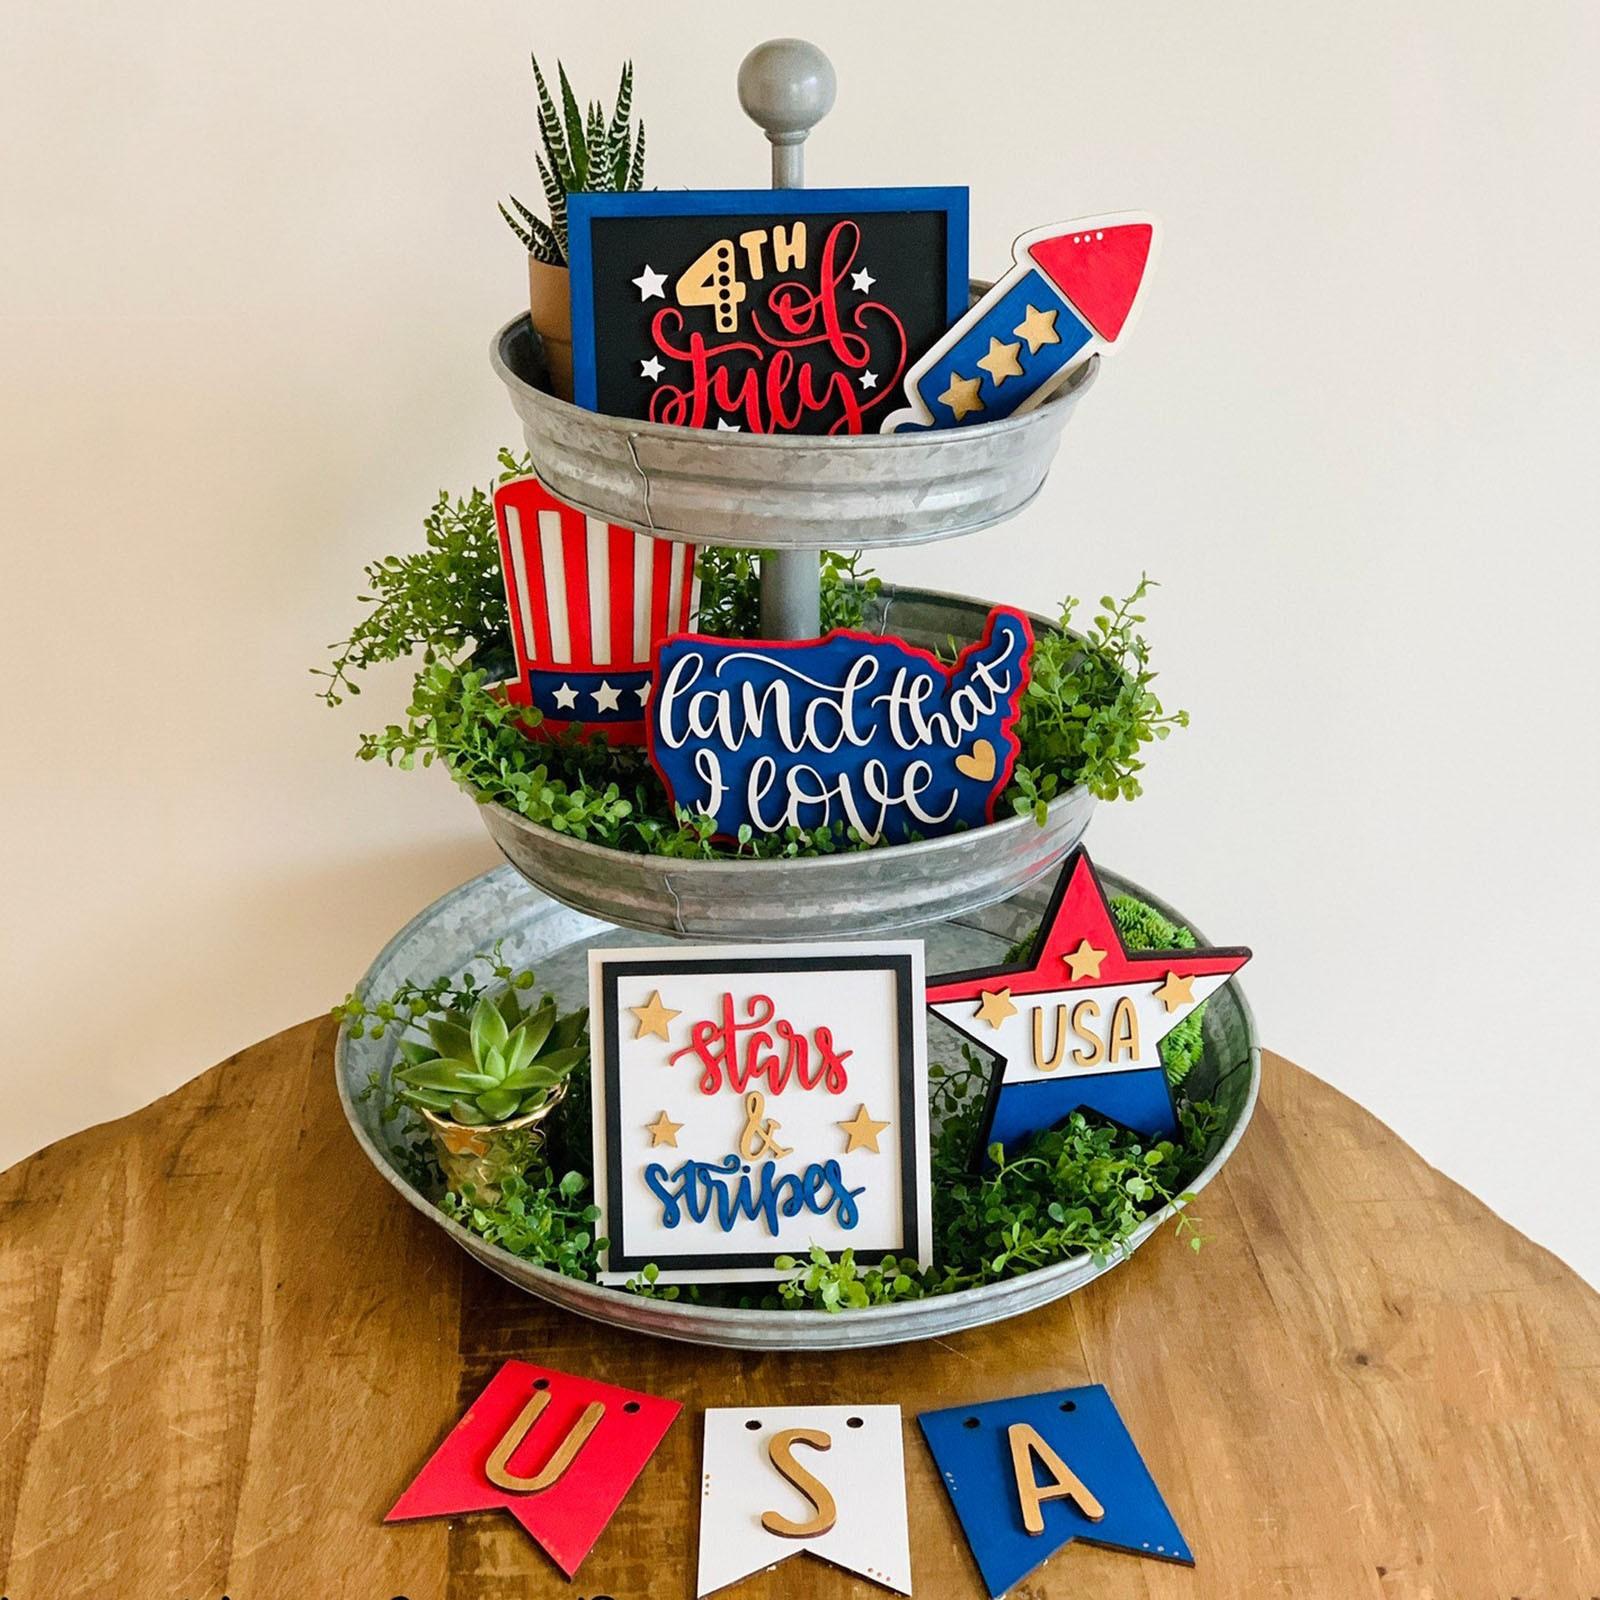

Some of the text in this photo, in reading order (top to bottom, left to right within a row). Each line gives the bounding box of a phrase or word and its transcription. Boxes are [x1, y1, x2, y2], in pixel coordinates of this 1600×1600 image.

[676, 219, 870, 368] 4TH of
[650, 302, 907, 436] July
[659, 628, 1014, 754] land that
[748, 755, 958, 845] love
[669, 991, 854, 1096] stars
[1032, 996, 1141, 1073] USA
[739, 1090, 794, 1162] &
[643, 1153, 867, 1237] stripes
